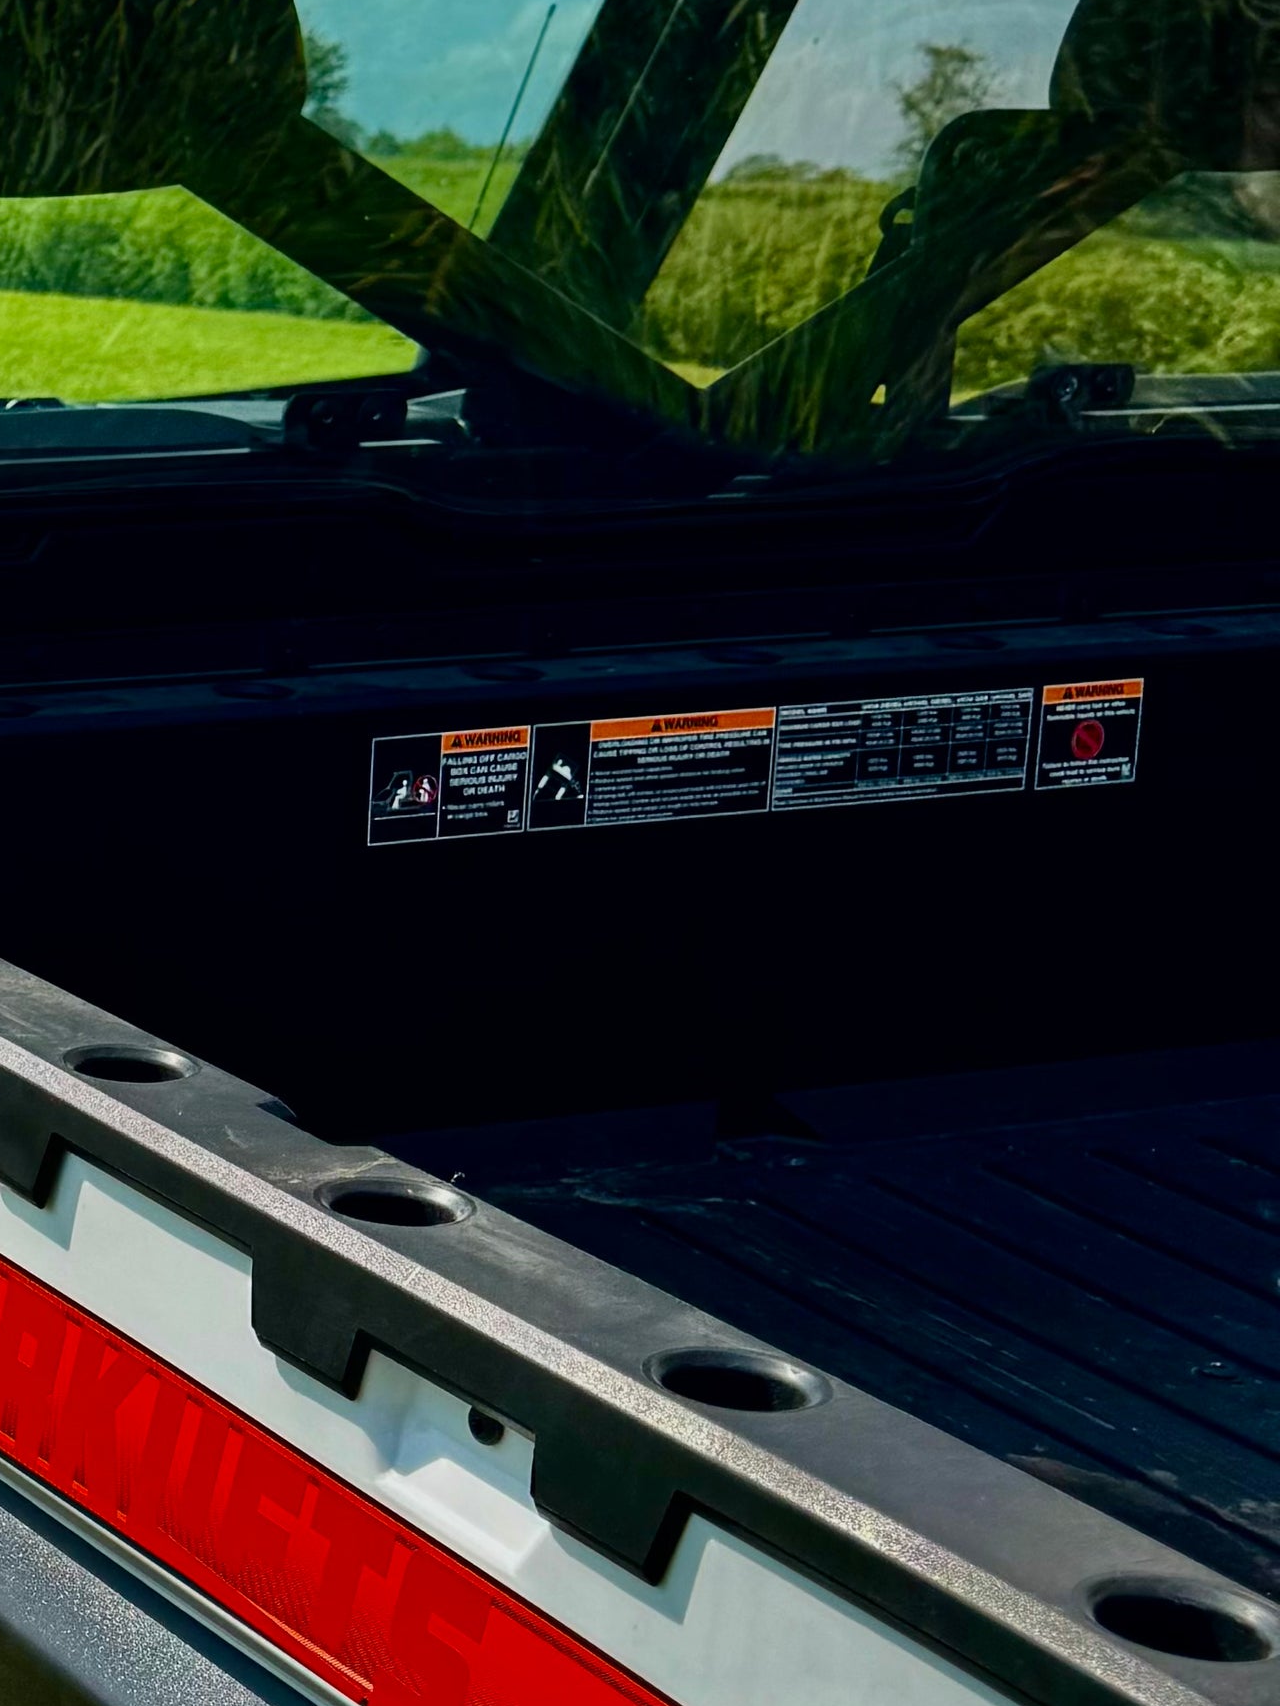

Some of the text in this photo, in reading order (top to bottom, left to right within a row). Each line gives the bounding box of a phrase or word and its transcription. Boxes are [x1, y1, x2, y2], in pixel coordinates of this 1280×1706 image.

[1074, 684, 1125, 699] WARNING
[664, 715, 718, 730] WARNING
[465, 730, 521, 747] WARNING
[479, 753, 495, 764] OFF
[496, 751, 528, 763] CARGO
[470, 765, 489, 775] CAN
[490, 763, 518, 773] CAUSE
[478, 785, 505, 795] DEATH
